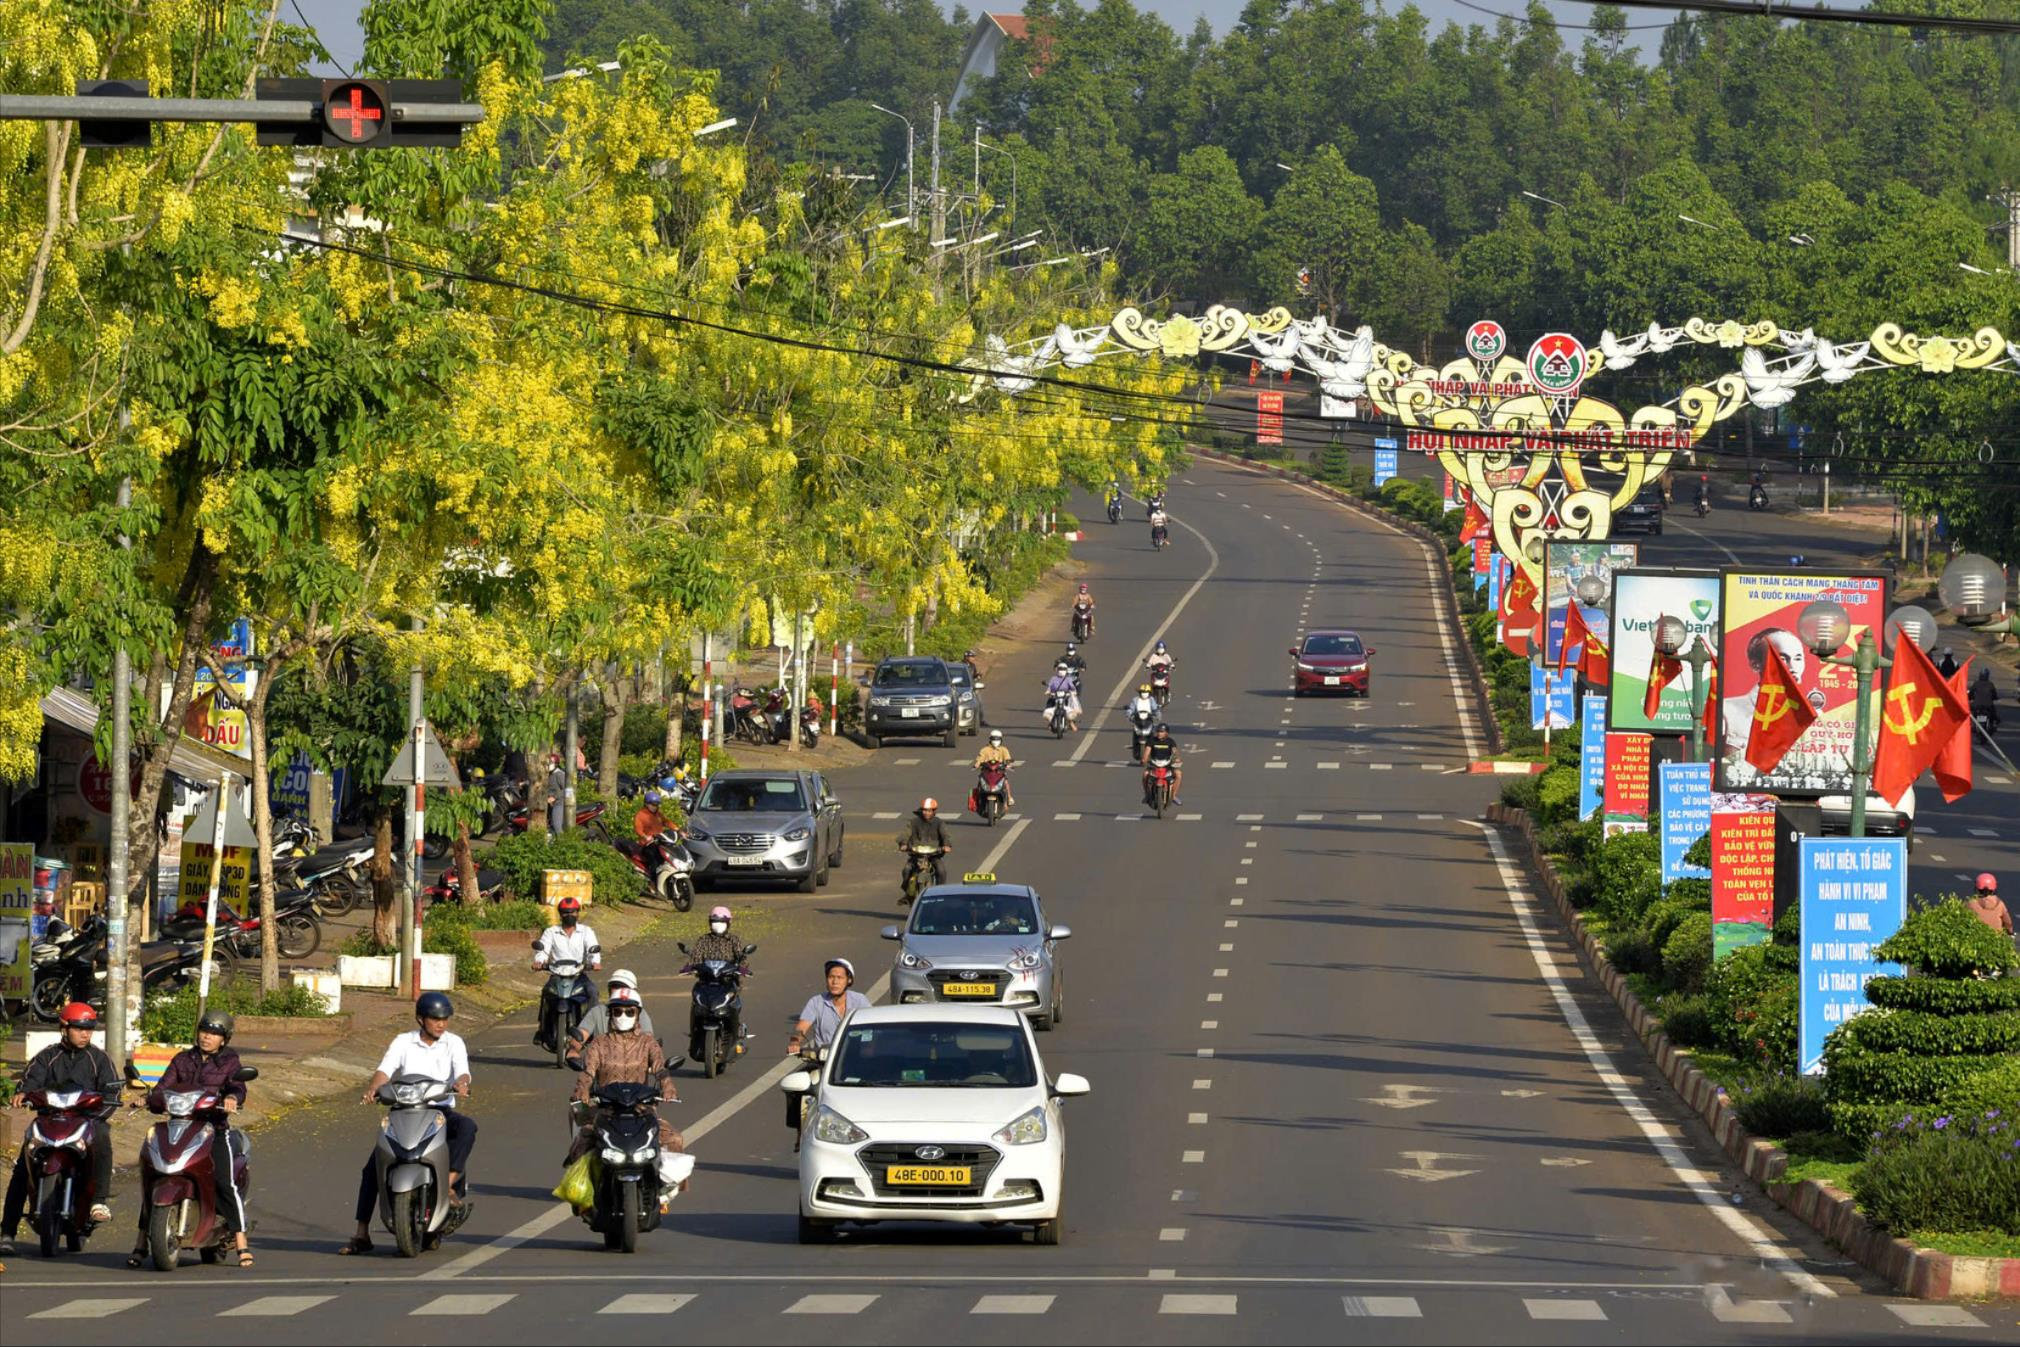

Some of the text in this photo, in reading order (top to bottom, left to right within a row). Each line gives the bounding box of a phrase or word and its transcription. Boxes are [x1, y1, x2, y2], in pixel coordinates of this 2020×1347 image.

[205, 717, 240, 745] DẤU
[1814, 848, 1835, 870] PHÁT
[1872, 848, 1892, 870] GIÁC
[1818, 879, 1888, 904] HÀNH VI VI PHẠM
[1834, 912, 1847, 931] AN
[1811, 943, 1823, 961] AN
[1825, 939, 1846, 961] TOÀN
[1818, 969, 1829, 991] LÀ
[1830, 969, 1857, 991] TRÁCH
[1824, 997, 1840, 1021] CỦA
[894, 1169, 964, 1182] 48E-000.10
